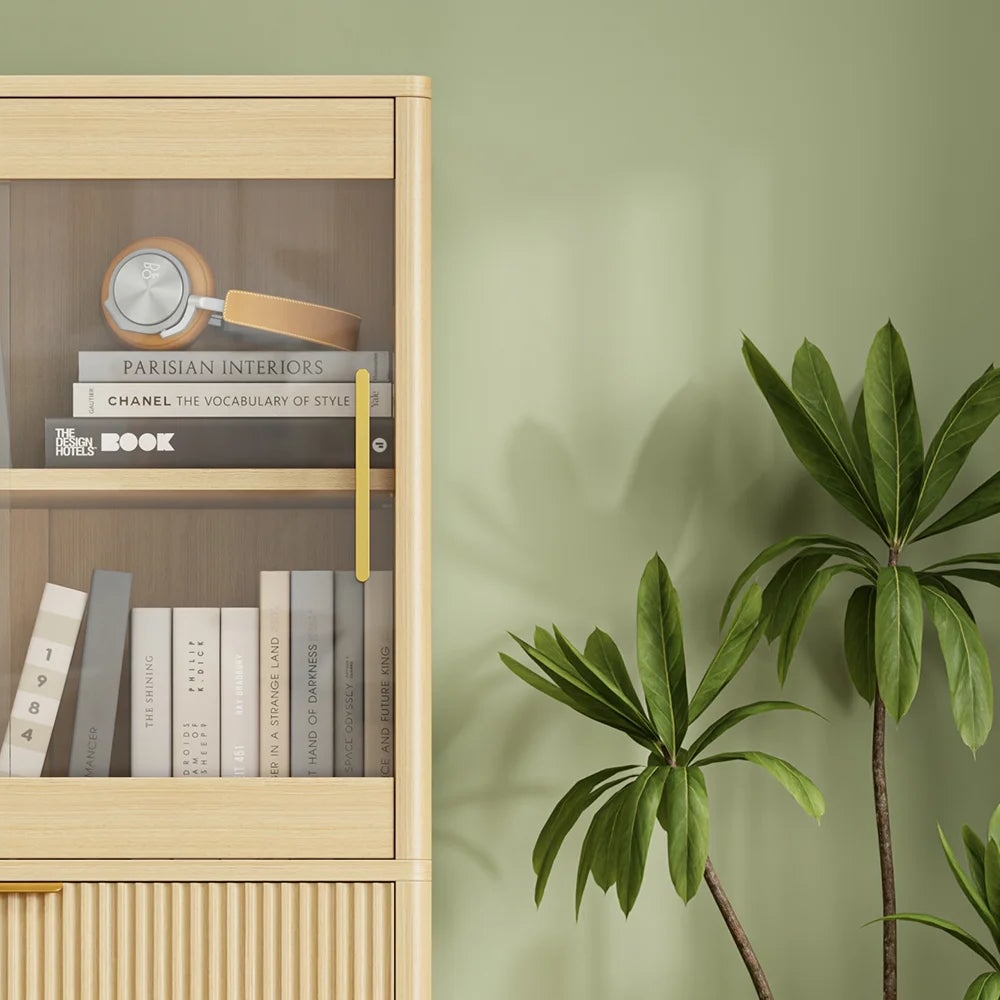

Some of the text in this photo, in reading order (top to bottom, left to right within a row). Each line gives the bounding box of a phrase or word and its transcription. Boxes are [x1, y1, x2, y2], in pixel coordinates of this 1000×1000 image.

[124, 360, 324, 375] PARISIAN INTERIORS
[108, 396, 350, 406] CHANEL THE VOCABULARY OF STYLE
[55, 428, 75, 438] THE
[56, 437, 93, 447] DESIGN
[101, 432, 175, 452] BOOK
[56, 446, 95, 456] HOTELS
[270, 636, 279, 668] LAND
[380, 646, 390, 676] KING
[308, 644, 318, 704] DARKNESS
[145, 655, 154, 728] THE SHINING
[270, 674, 279, 726] STRANGE
[380, 681, 390, 722] FUTURE
[308, 708, 318, 726] OF
[344, 682, 354, 734] ODYSSEY
[192, 722, 198, 738] OF
[270, 732, 279, 740] A
[380, 727, 390, 753] AND
[270, 744, 279, 756] IN
[308, 730, 318, 765] HAND
